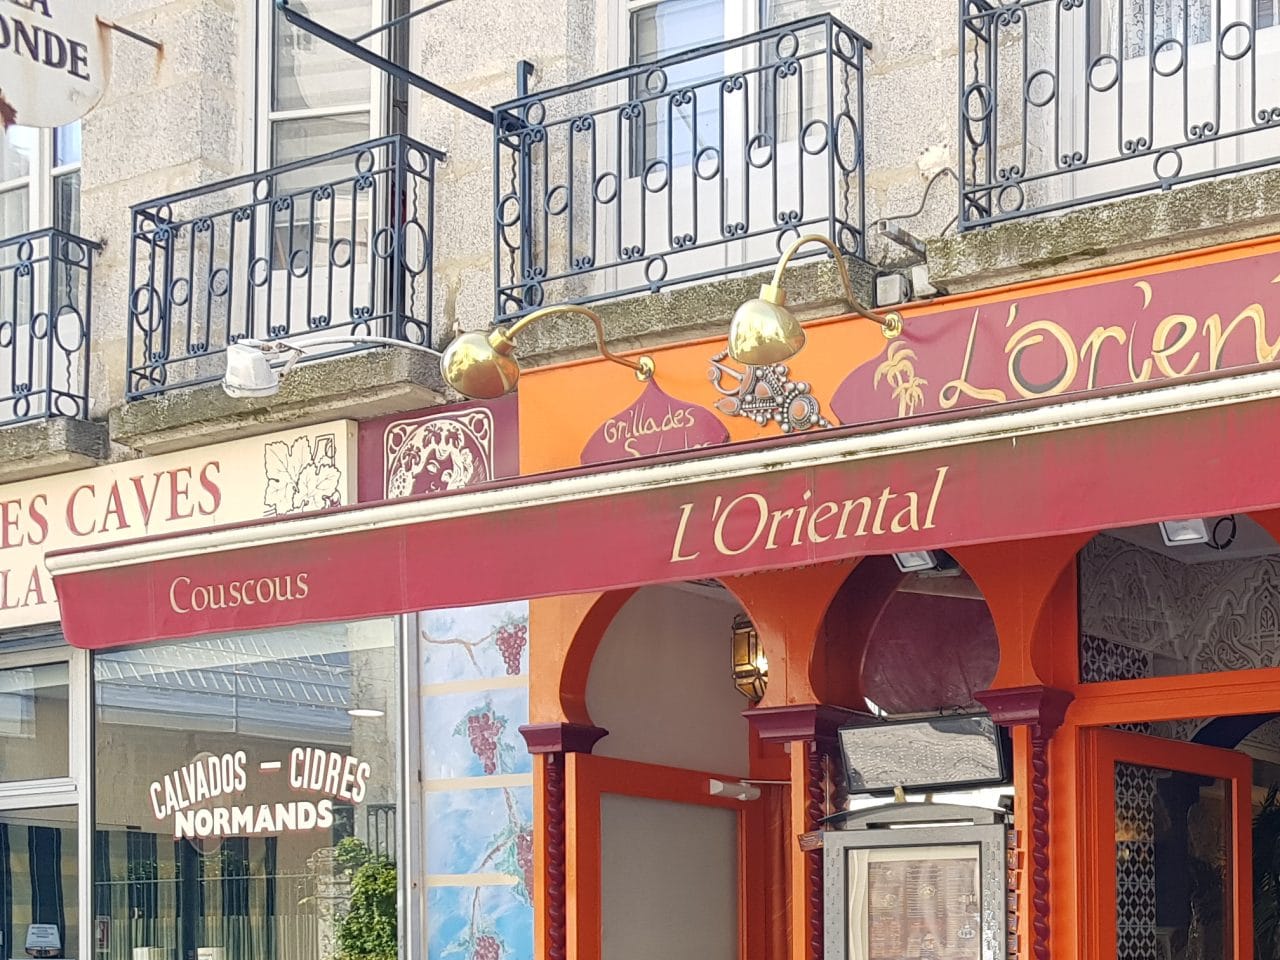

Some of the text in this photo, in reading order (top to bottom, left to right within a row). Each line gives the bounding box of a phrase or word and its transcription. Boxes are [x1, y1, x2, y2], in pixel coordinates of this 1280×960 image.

[603, 401, 696, 443] Grillades
[65, 460, 222, 537] CAVES
[669, 466, 950, 562] L'Oriental
[169, 572, 309, 614] Couscous
[150, 750, 247, 821] CALVADOS
[289, 747, 371, 804] CIDRES
[174, 800, 334, 839] NORMANDS
